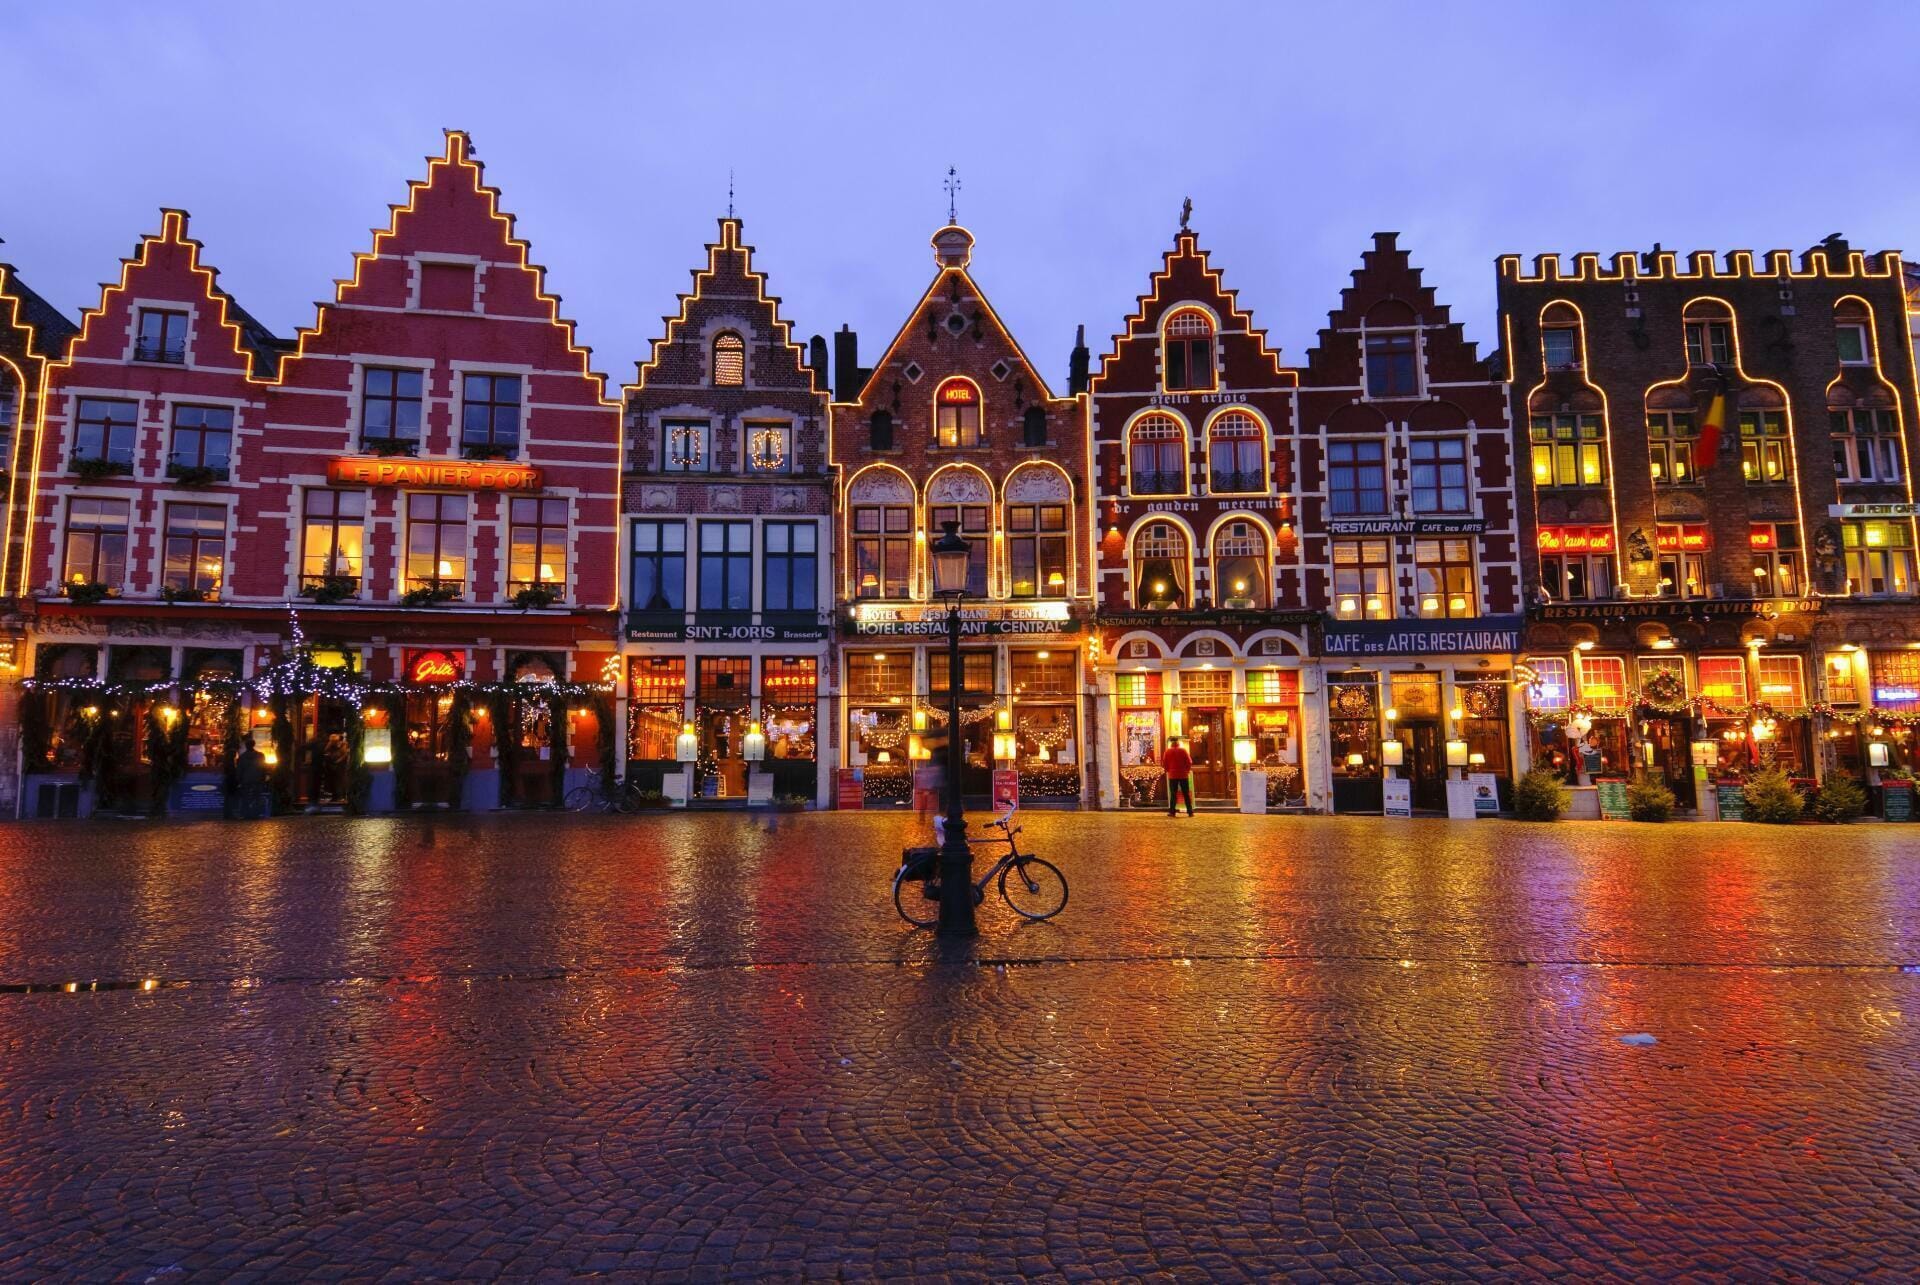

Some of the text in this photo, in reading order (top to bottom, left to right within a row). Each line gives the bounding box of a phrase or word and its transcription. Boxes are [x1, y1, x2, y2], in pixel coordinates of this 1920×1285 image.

[946, 389, 971, 400] HOTEL
[1150, 393, 1247, 404] stella artois
[336, 464, 537, 488] LE PANIER D'OR
[1114, 497, 1283, 514] de gouden meermin
[1331, 521, 1416, 533] RESTAURANT
[1422, 524, 1442, 532] CAFE
[1462, 523, 1482, 532] ARTS
[1544, 604, 1660, 618] RESTAURANT
[1670, 603, 1692, 615] LA
[1782, 600, 1821, 612] D'OR
[631, 626, 823, 639] Restaurant SINT-JORIS Brasserie
[856, 621, 988, 635] HOTEL-RESTAUANT
[1365, 643, 1384, 652] DES
[636, 676, 816, 688] STELLA ARTOIS
